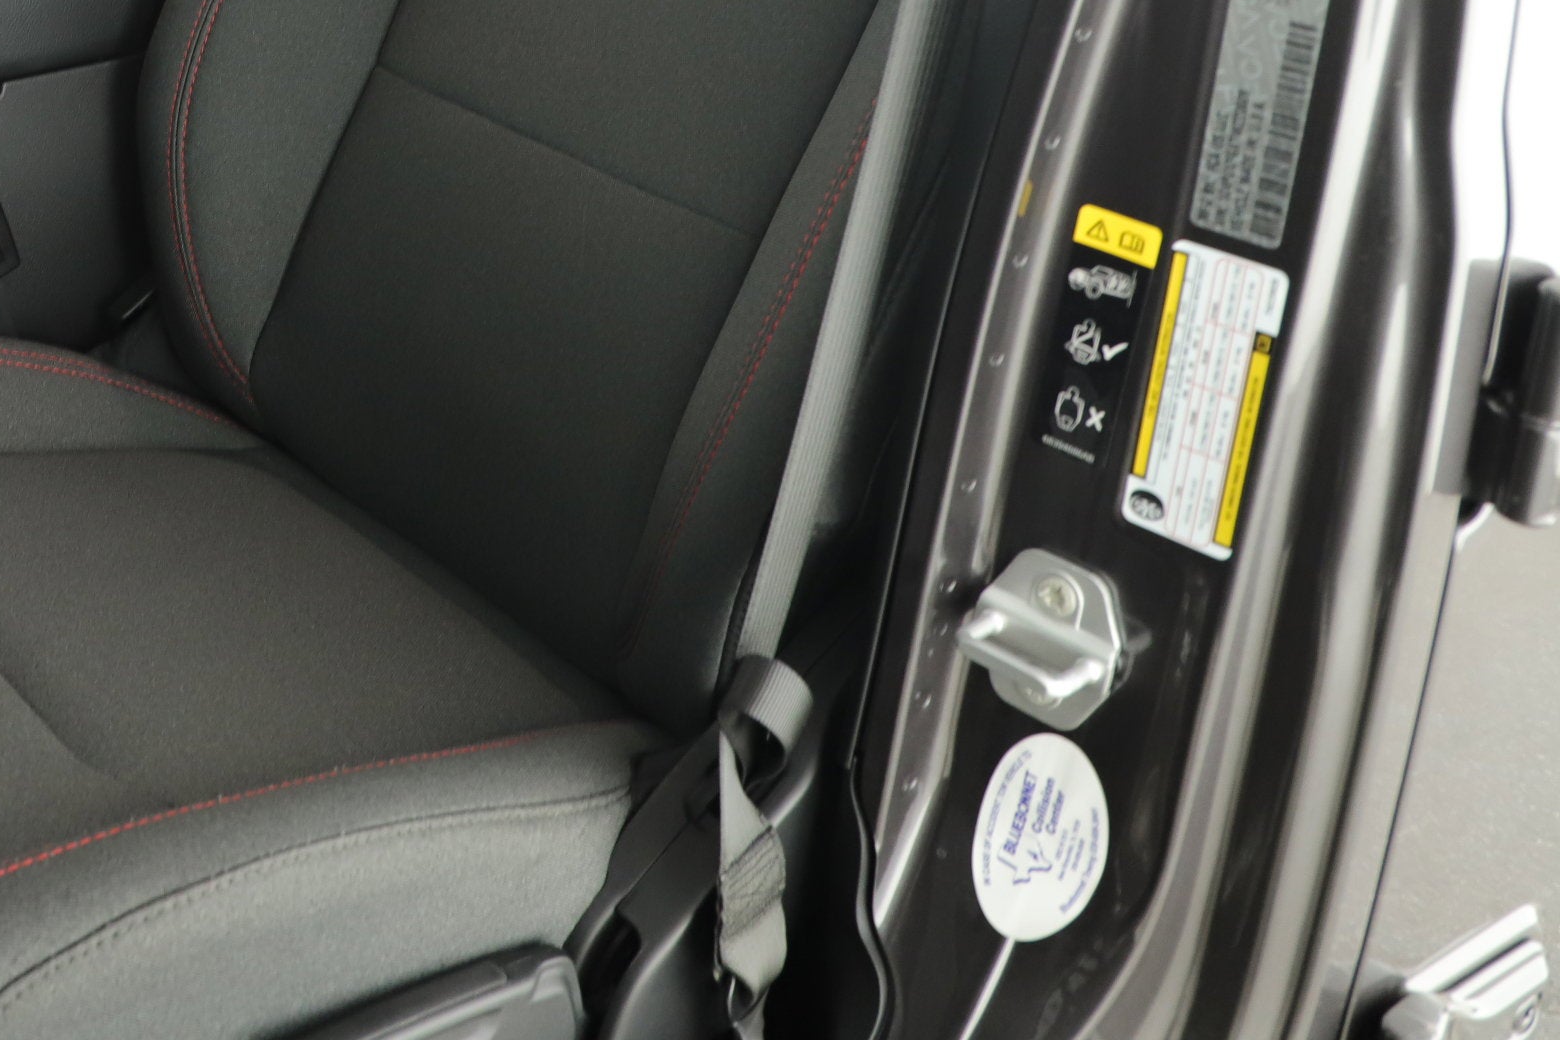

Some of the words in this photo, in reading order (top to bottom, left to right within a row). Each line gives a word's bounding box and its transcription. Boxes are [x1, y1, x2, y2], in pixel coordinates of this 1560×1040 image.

[1002, 769, 1038, 855] BLUEBONNET
[1031, 776, 1055, 834] Collision
[1045, 789, 1066, 835] Center
